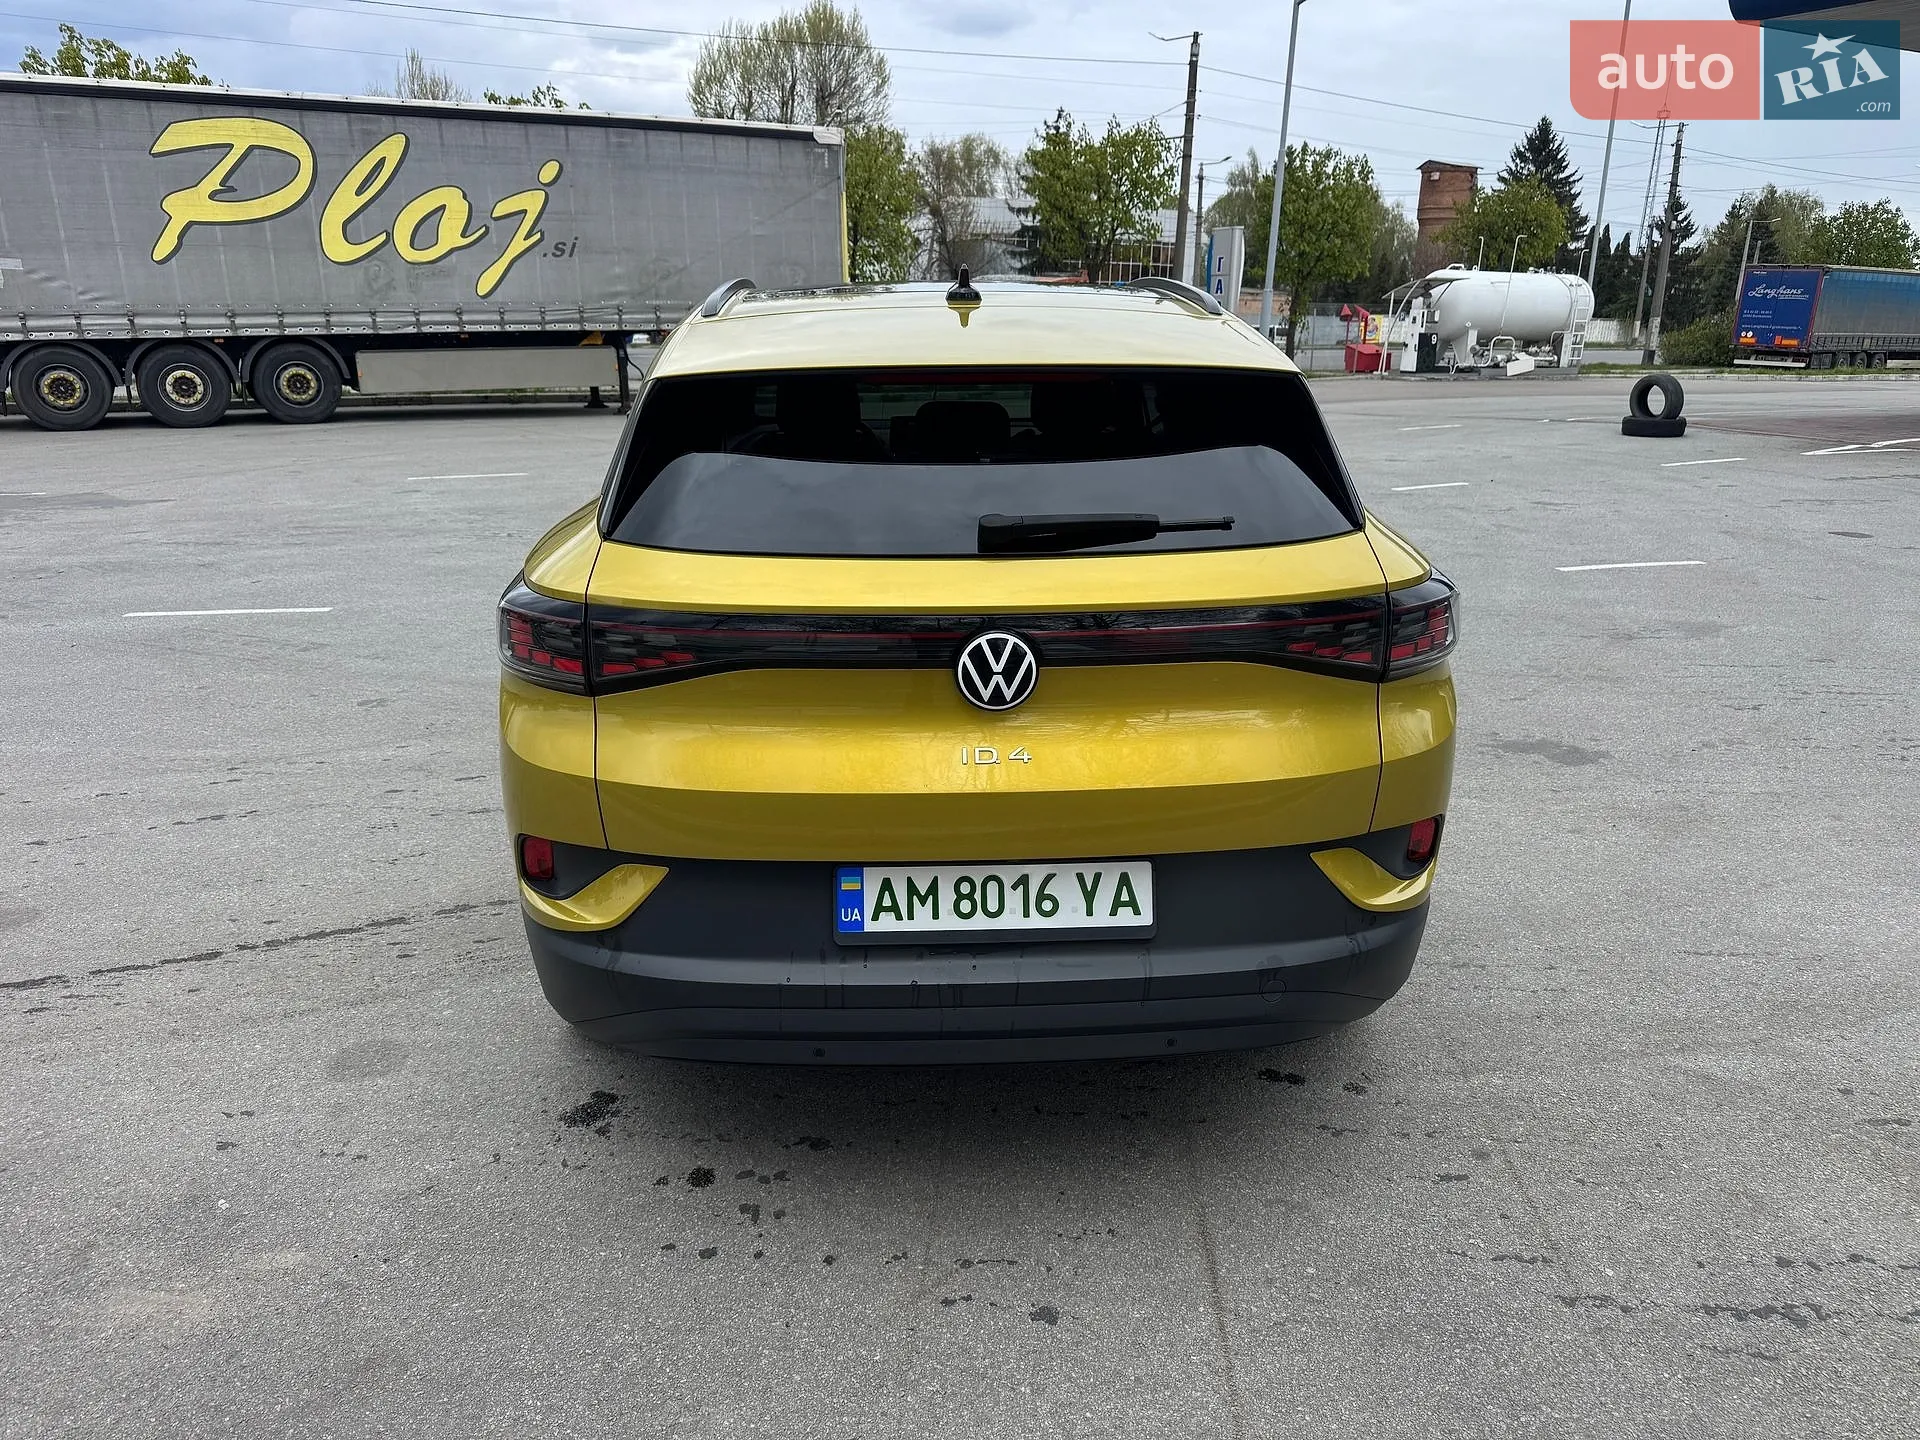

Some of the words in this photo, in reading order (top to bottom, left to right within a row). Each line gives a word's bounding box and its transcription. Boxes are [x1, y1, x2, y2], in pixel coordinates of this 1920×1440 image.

[1748, 283, 1804, 299] Langhans
[1431, 334, 1437, 344] 9
[870, 876, 939, 922] AM
[953, 872, 1060, 919] 8016
[1076, 871, 1142, 917] YA
[841, 907, 861, 922] UA
